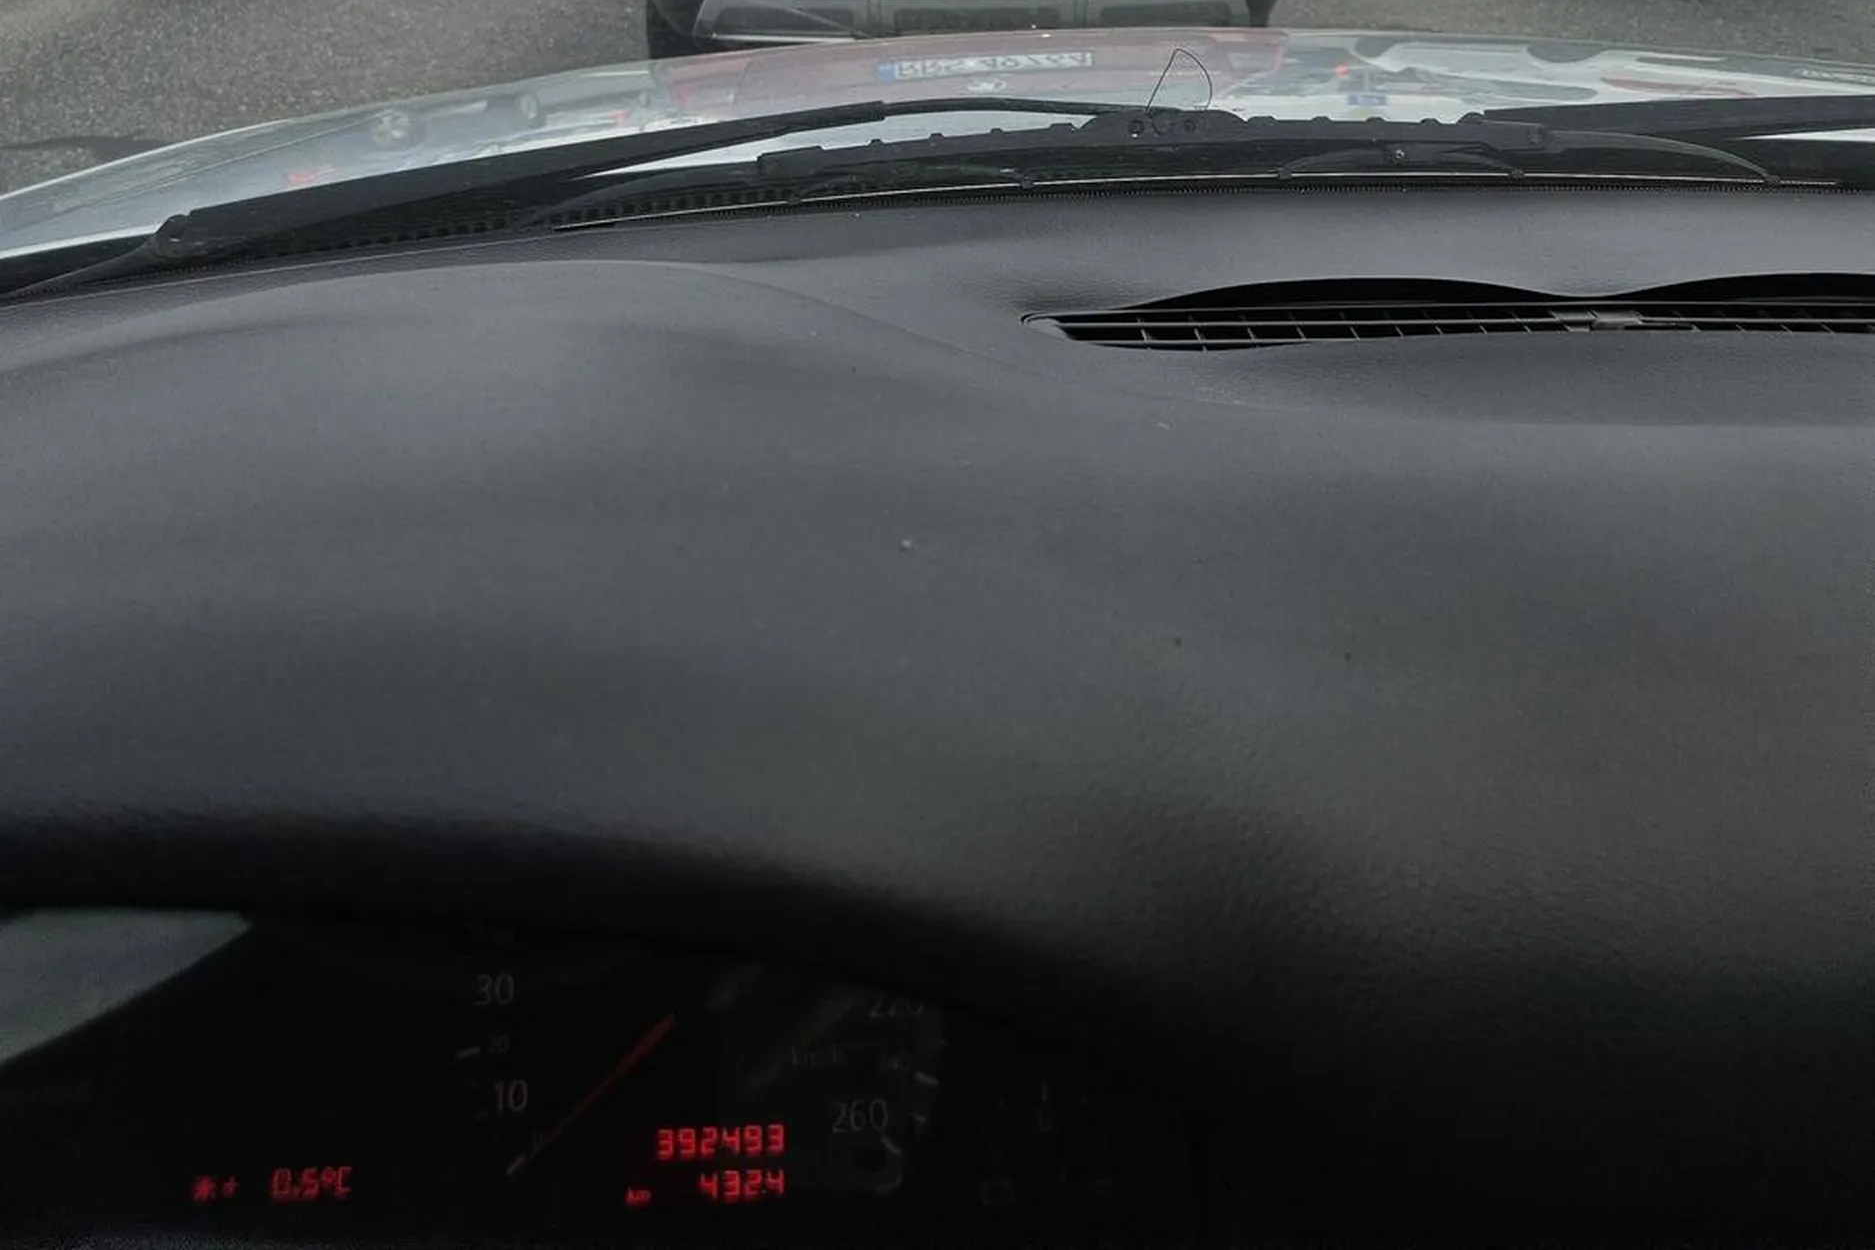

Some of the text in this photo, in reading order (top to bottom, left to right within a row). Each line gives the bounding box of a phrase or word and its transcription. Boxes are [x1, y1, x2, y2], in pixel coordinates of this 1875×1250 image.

[473, 971, 515, 1007] 30
[494, 1078, 529, 1113] 10
[832, 1097, 889, 1134] 260
